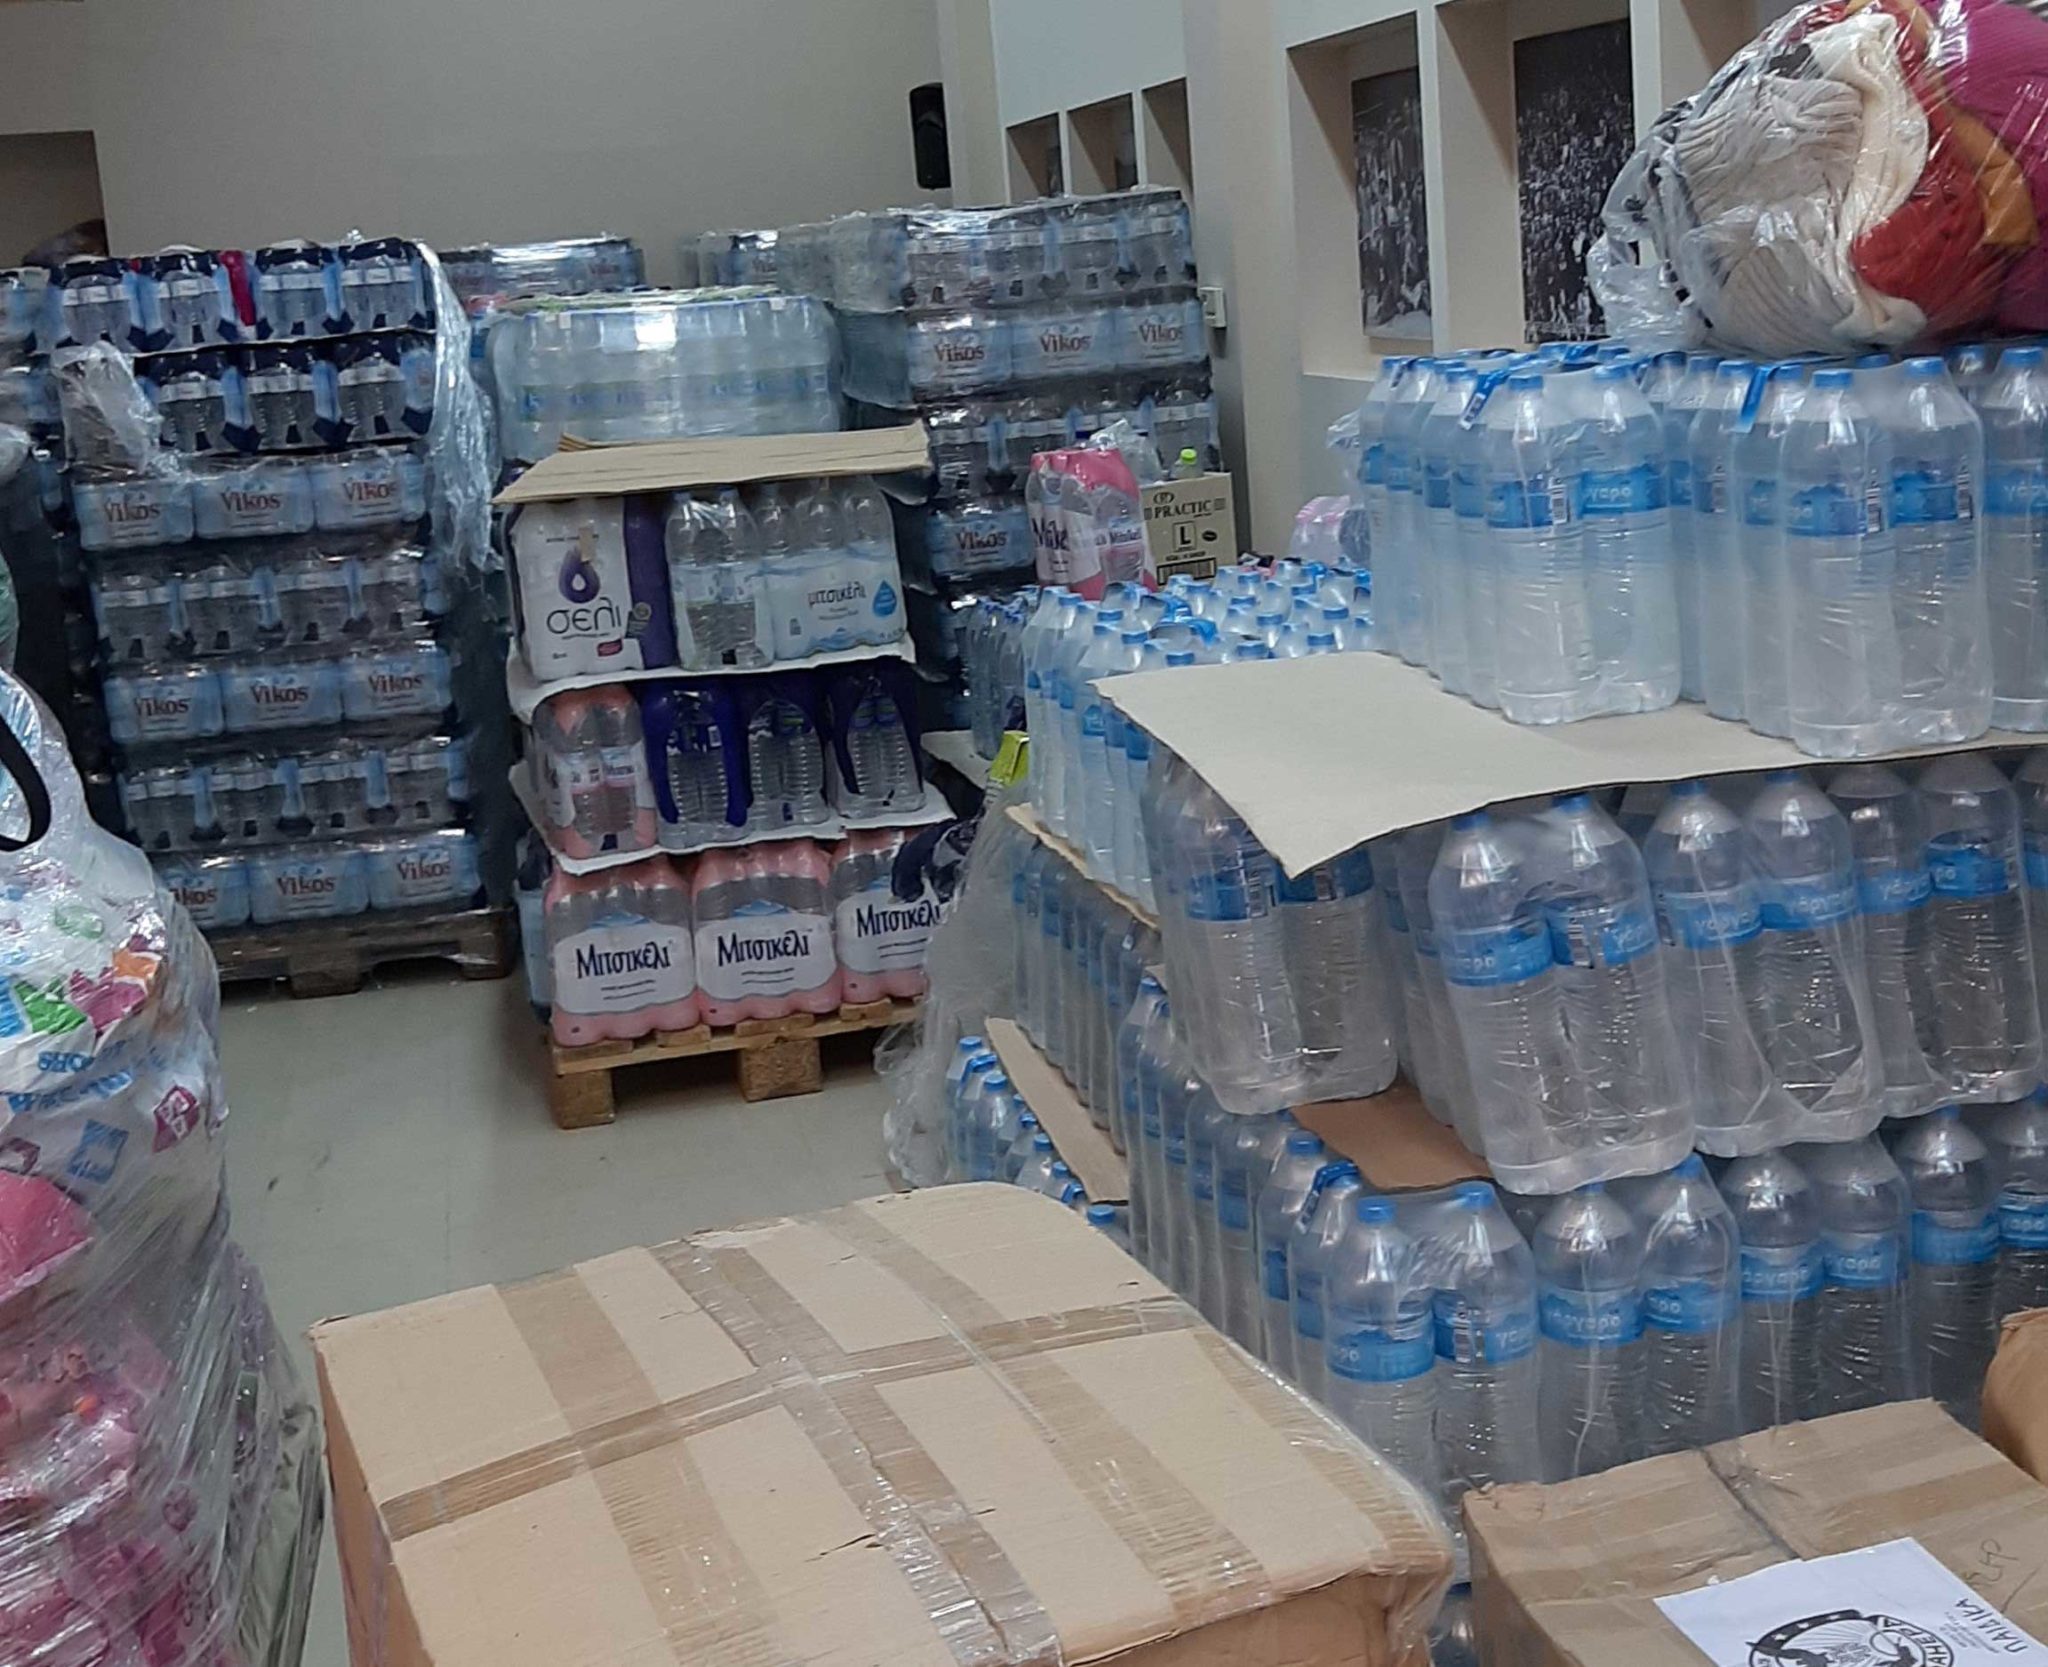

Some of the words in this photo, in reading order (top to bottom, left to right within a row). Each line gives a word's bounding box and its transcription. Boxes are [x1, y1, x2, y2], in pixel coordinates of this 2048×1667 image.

[1040, 333, 1092, 353] Vikos
[220, 491, 282, 512] Vikos
[1154, 500, 1212, 519] PRACTIC
[1180, 526, 1192, 545] L
[368, 673, 425, 694] Vikos
[250, 684, 309, 705] Vikos
[276, 876, 337, 897] Vikos
